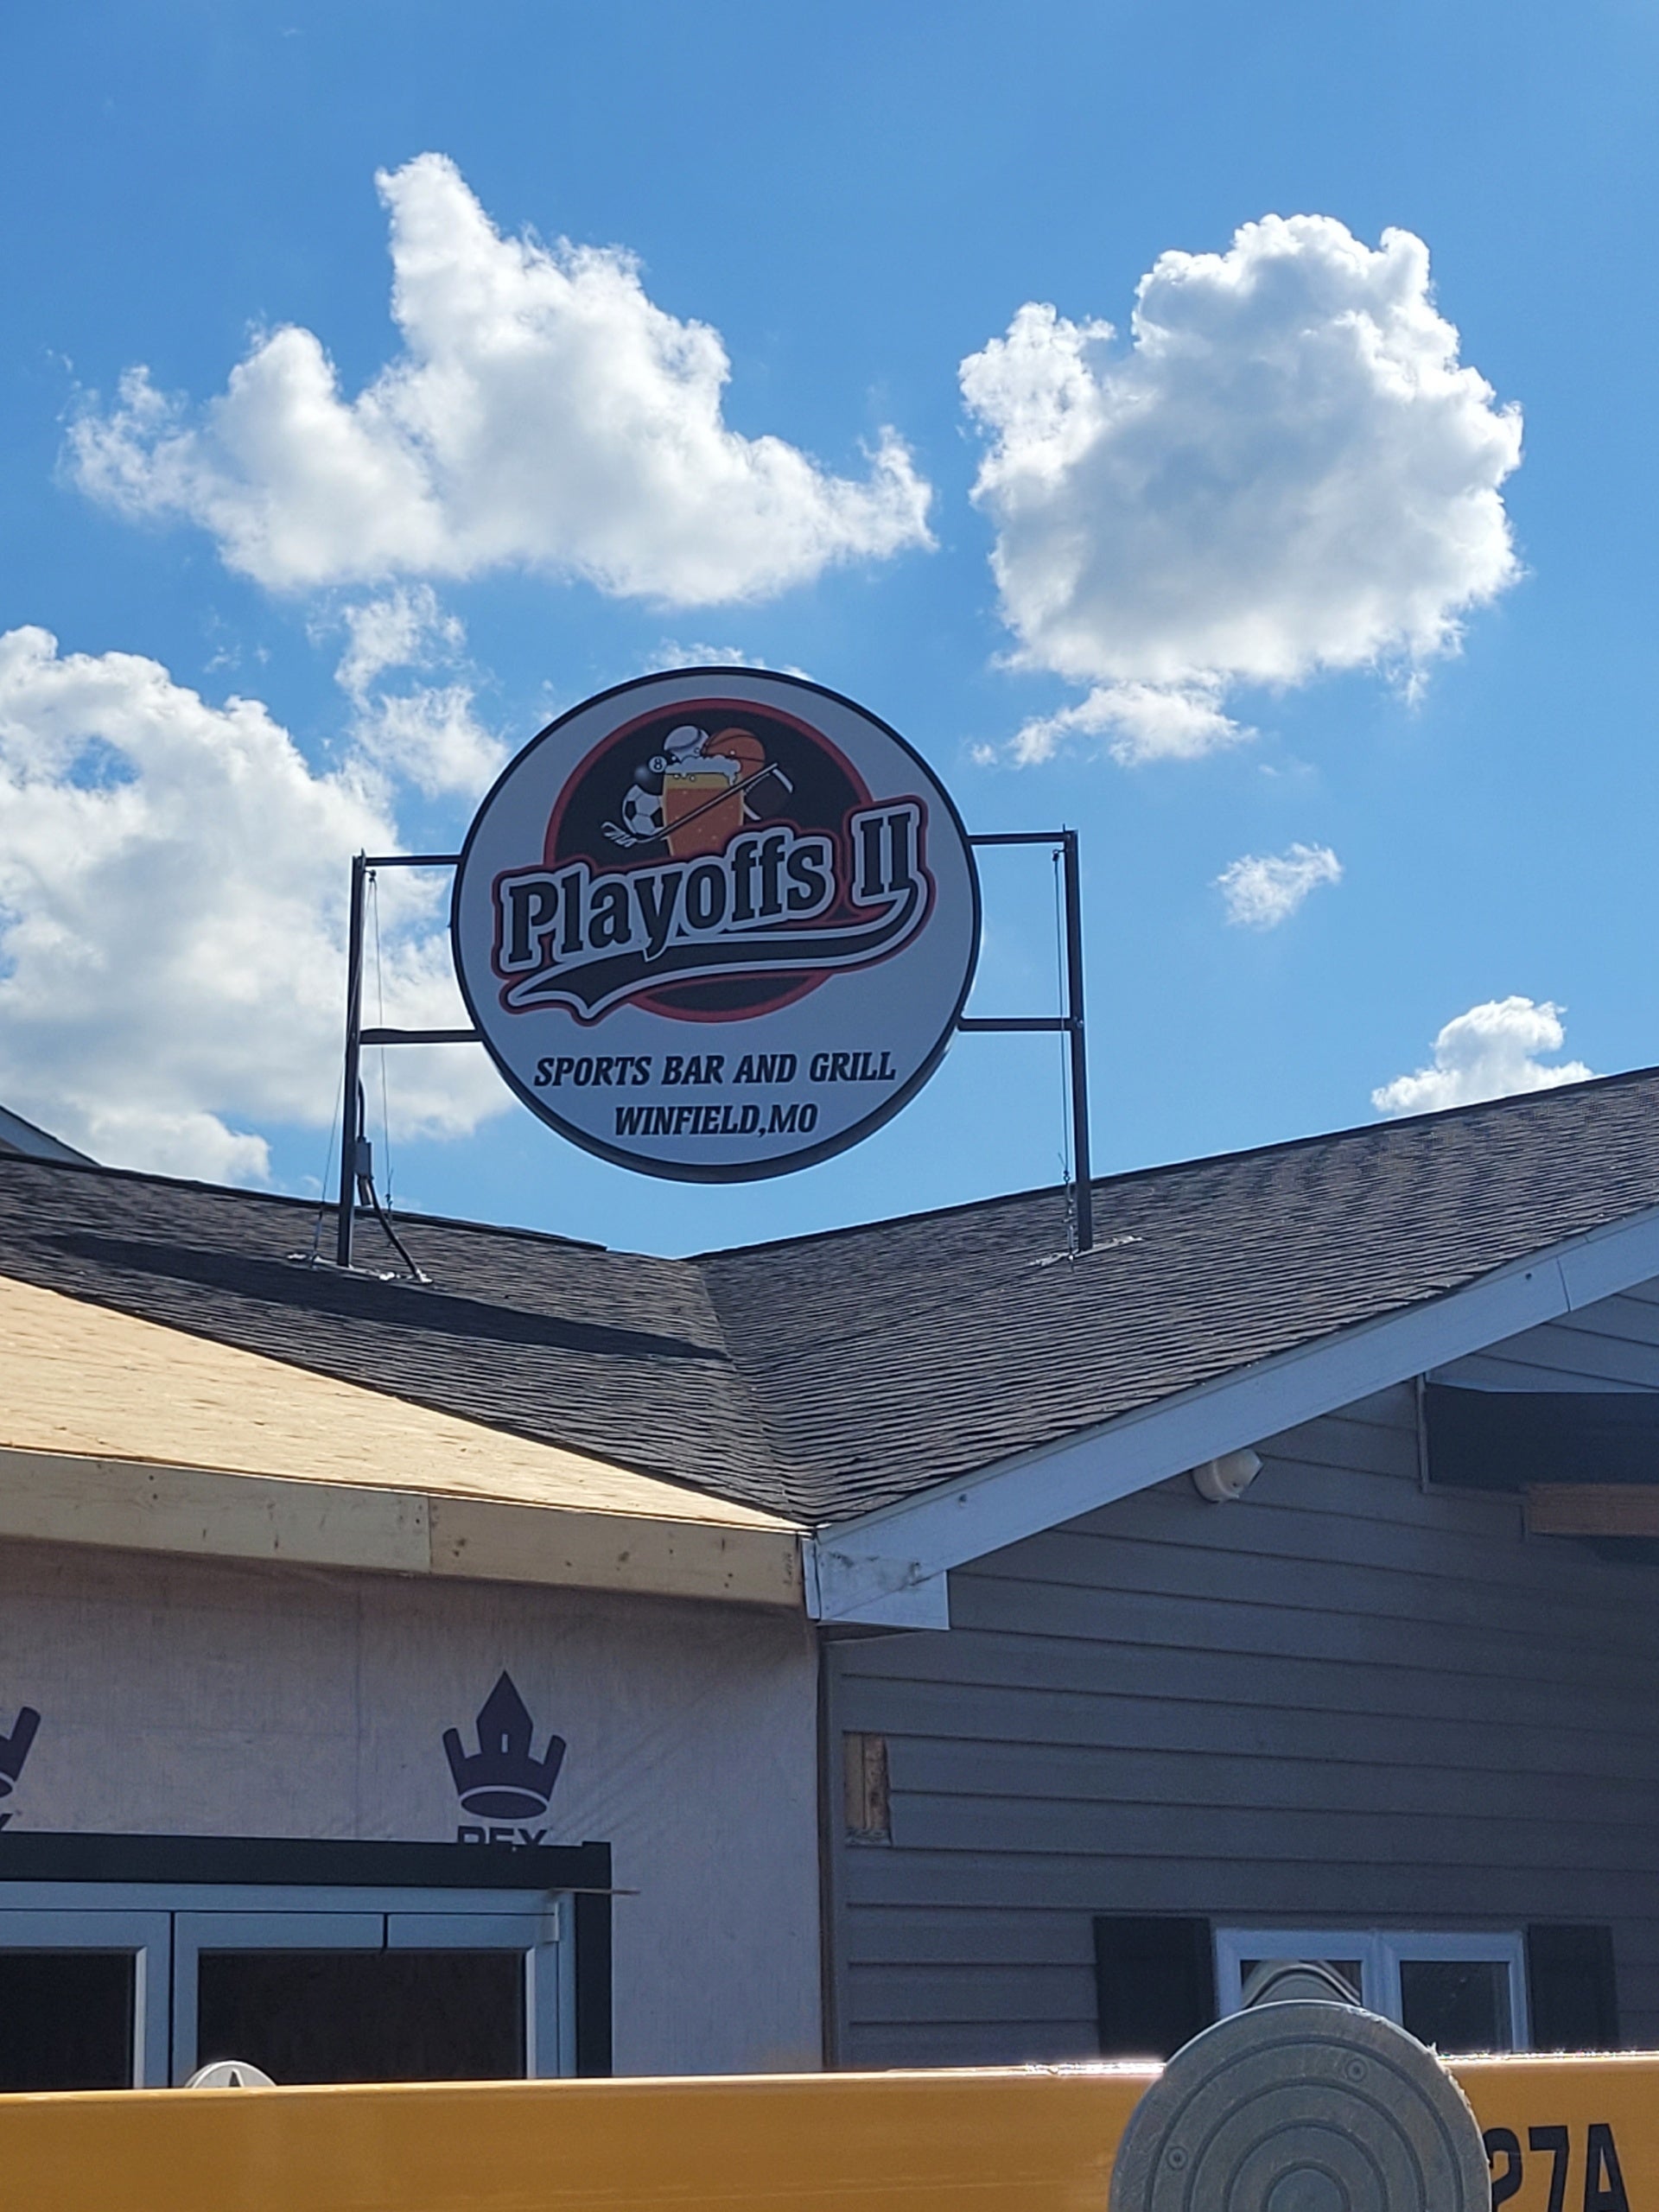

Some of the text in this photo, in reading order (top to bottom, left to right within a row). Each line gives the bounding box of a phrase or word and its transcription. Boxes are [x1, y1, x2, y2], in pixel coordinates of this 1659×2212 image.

[508, 834, 826, 964] Playoffs
[534, 1052, 896, 1086] SPORTS BAR AND GRILL
[615, 1103, 817, 1137] WINFIELD,MO
